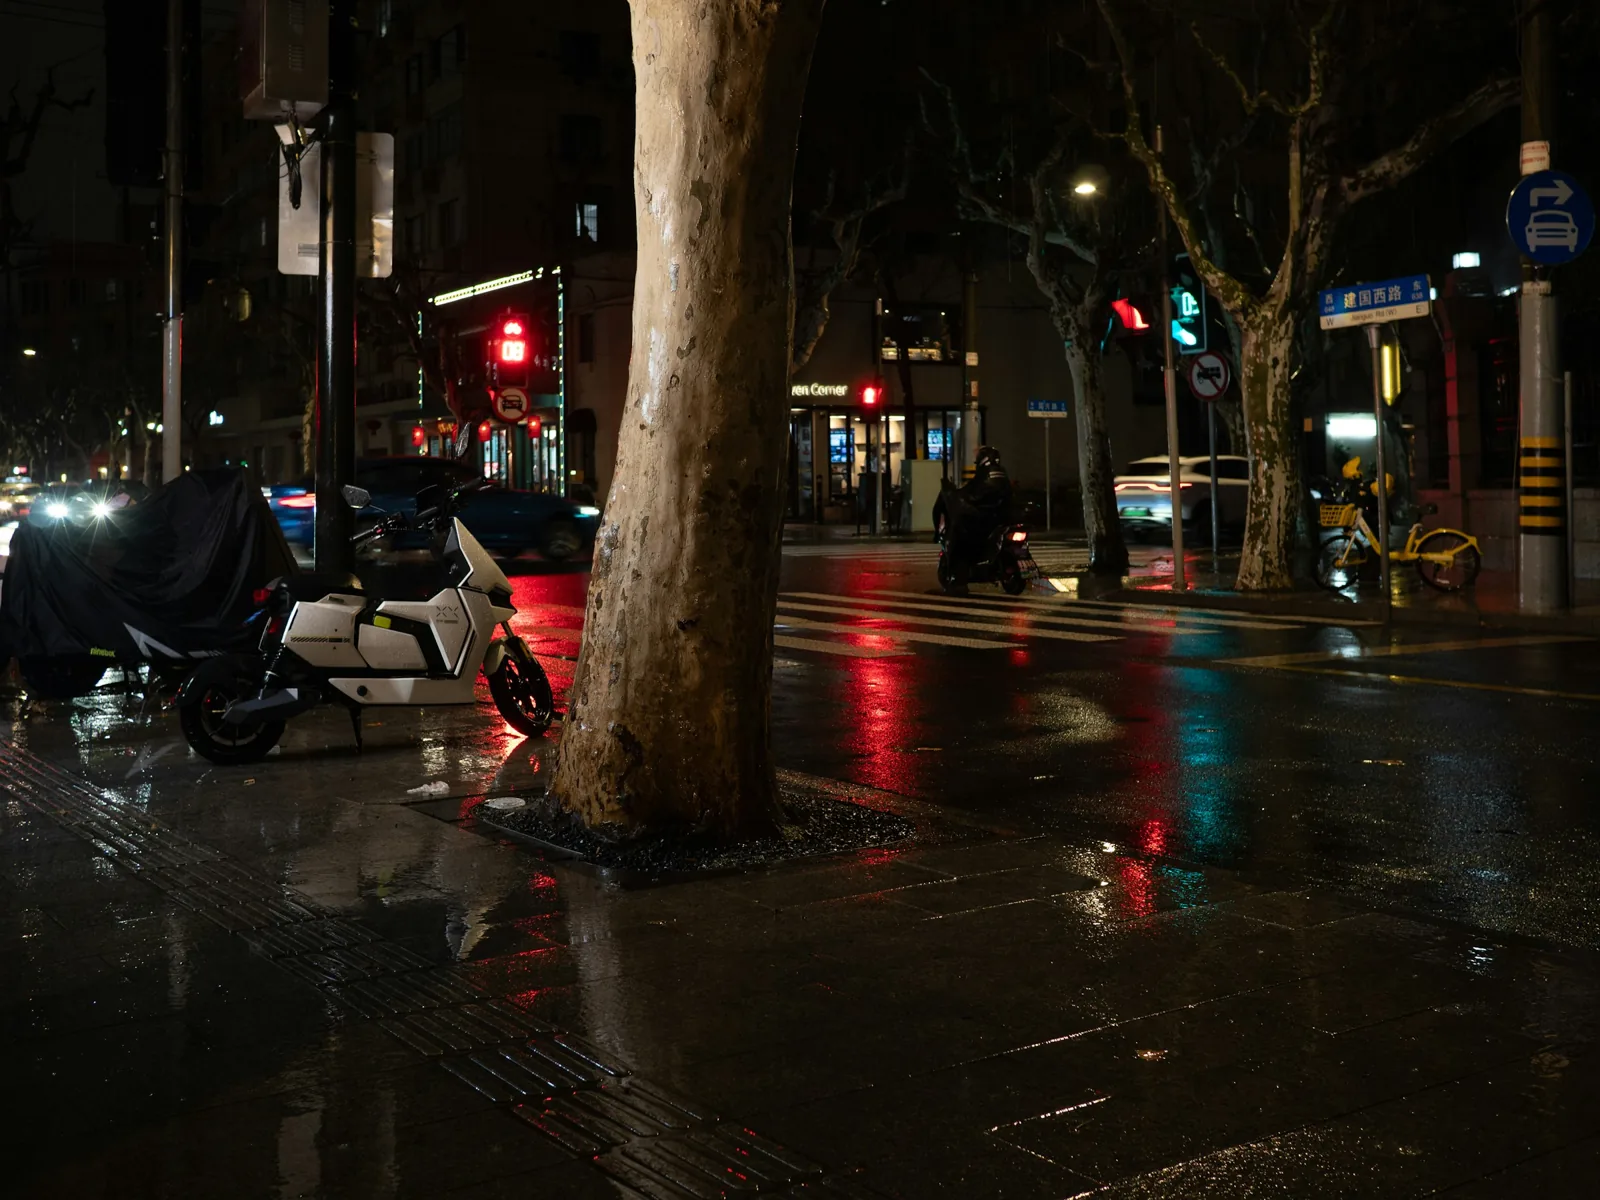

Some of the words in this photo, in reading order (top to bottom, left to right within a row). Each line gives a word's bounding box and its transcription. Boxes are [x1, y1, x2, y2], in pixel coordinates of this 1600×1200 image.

[1325, 293, 1334, 305] 西
[1343, 285, 1402, 309] 建国西路
[1416, 305, 1422, 314] E
[1326, 317, 1334, 326] W
[810, 382, 848, 396] Corner
